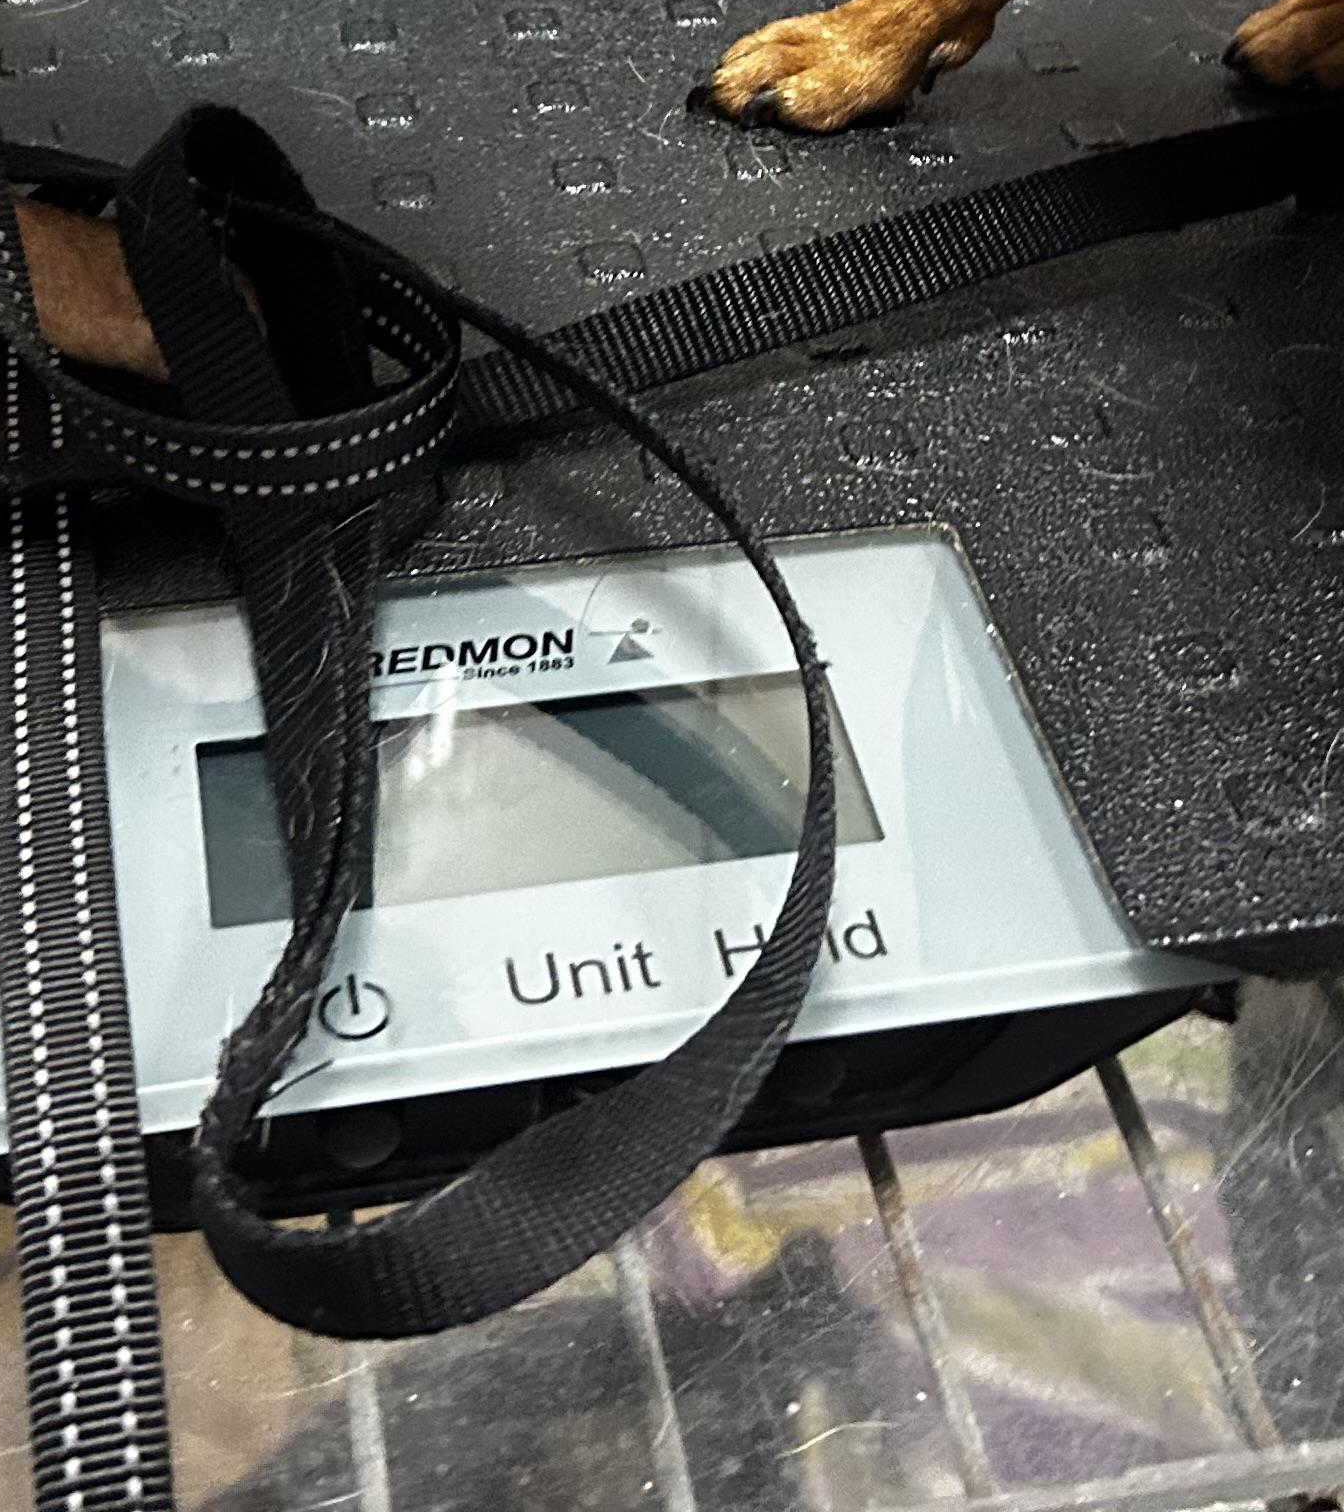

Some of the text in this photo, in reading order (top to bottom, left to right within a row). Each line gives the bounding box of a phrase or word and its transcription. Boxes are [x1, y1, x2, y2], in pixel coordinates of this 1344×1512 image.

[463, 656, 575, 681] Since 1883
[505, 909, 888, 1005] Unit Hld
